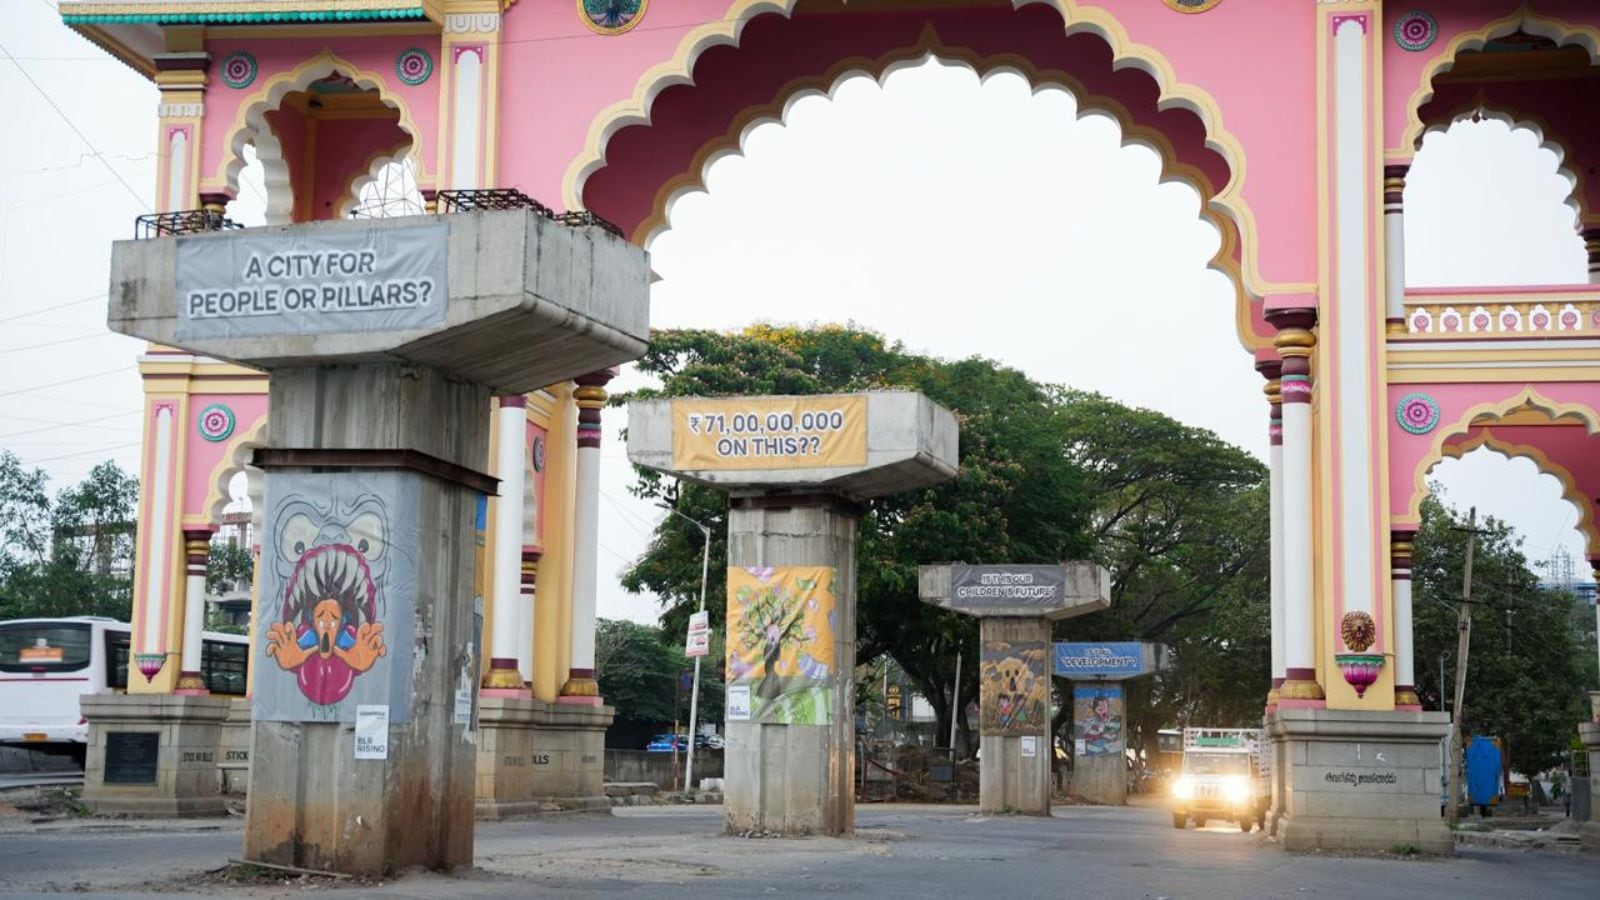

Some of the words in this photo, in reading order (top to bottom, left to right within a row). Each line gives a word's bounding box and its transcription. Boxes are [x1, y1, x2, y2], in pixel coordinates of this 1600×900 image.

[246, 256, 262, 278] A
[267, 254, 322, 278] CITY
[326, 252, 375, 275] FOR
[189, 290, 278, 315] PEOPLE
[284, 288, 317, 310] OR
[322, 281, 432, 309] PILLARS?
[705, 412, 843, 434] 71,00,00,000
[718, 438, 747, 456] ON
[752, 436, 821, 456] THIS??
[983, 575, 991, 583] IS
[992, 574, 1012, 584] THIS
[1013, 574, 1033, 584] OUR
[959, 586, 1014, 597] CHILDREN'S
[1015, 586, 1057, 597] FUTURE?
[357, 736, 372, 744] BLR
[357, 745, 385, 753] RISING
[225, 751, 249, 760] STICK
[532, 755, 549, 764] ILLS
